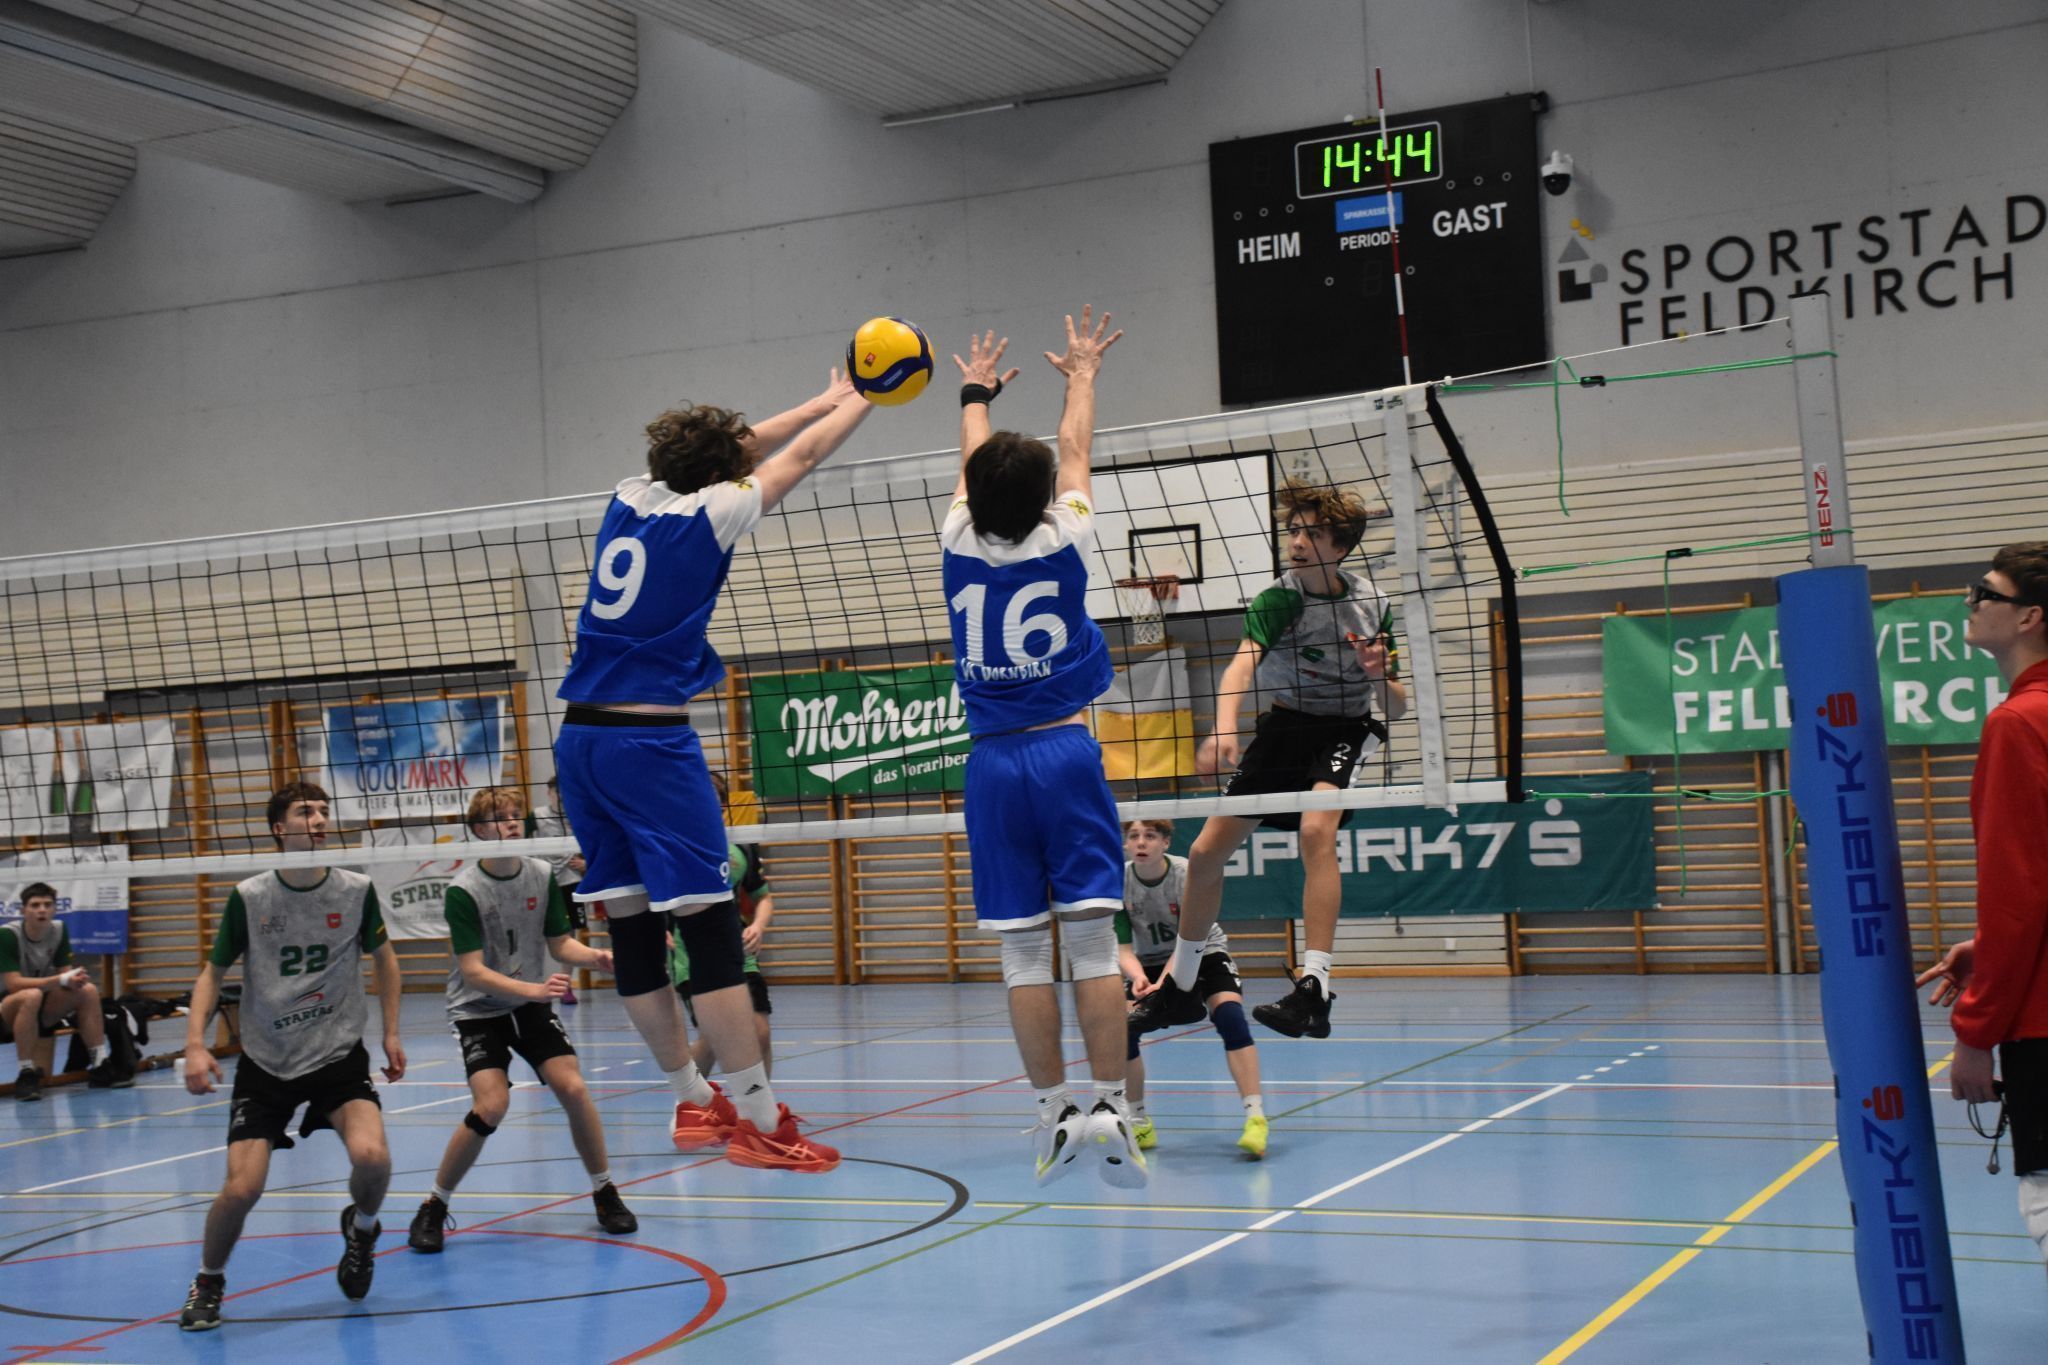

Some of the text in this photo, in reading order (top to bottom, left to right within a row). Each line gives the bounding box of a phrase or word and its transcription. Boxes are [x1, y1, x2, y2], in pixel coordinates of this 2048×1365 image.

[1323, 131, 1432, 188] 14:44
[1432, 202, 1507, 237] GAST
[1238, 231, 1300, 264] HEIM
[1814, 471, 1834, 547] BENZ
[590, 537, 647, 620] 9
[950, 580, 1068, 668] 16
[873, 769, 898, 785] das
[719, 861, 730, 885] 9
[1147, 921, 1177, 946] 16
[280, 944, 329, 977] 22
